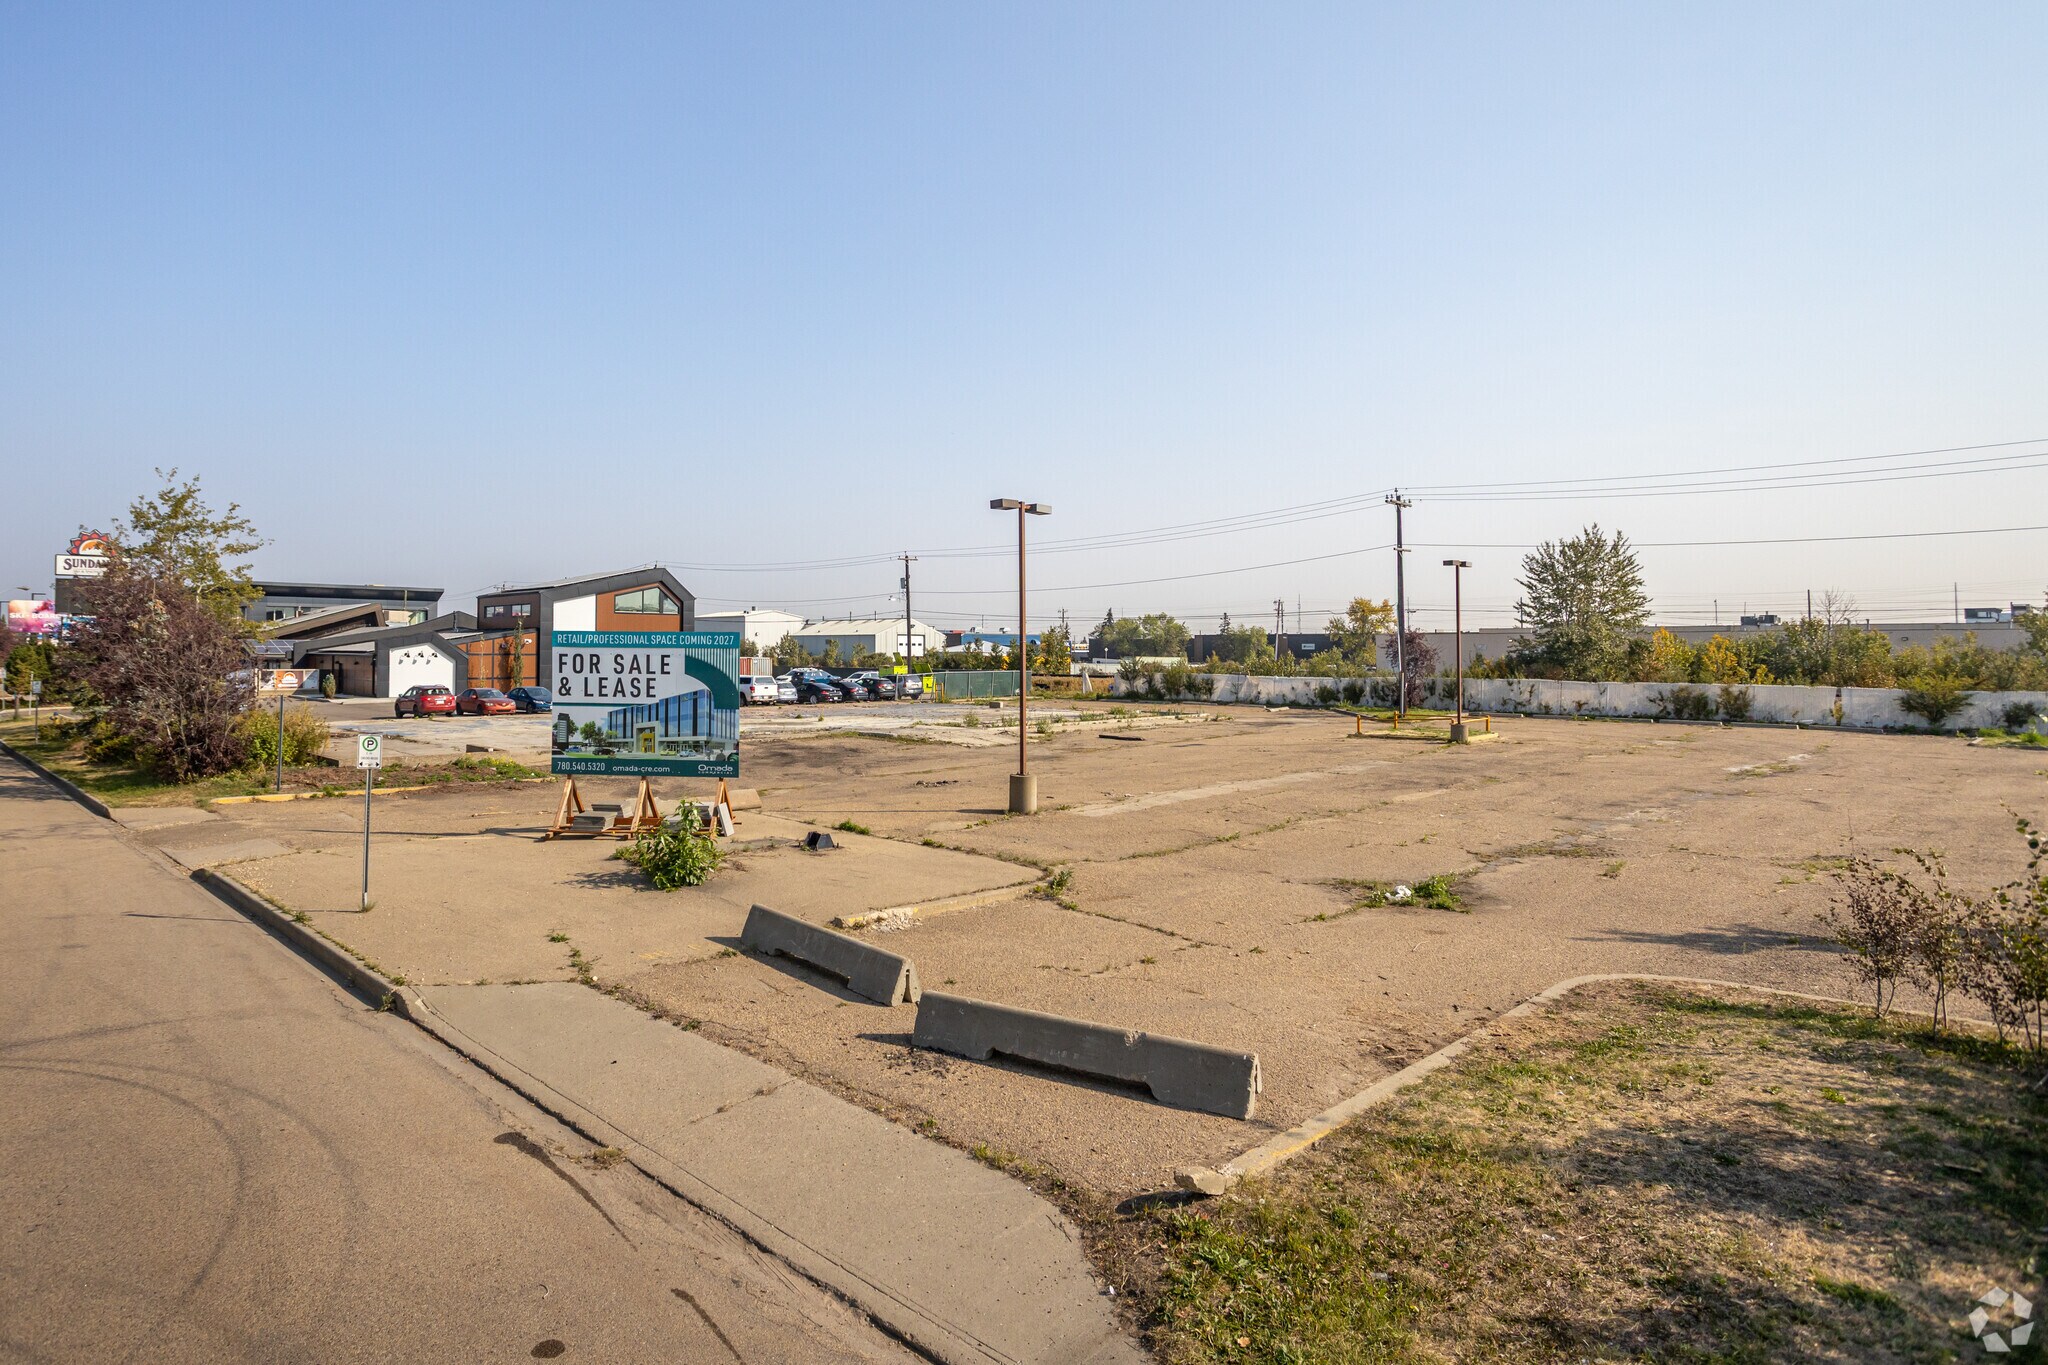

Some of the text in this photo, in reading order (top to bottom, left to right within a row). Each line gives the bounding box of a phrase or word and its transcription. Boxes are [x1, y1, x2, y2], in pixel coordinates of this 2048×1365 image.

[557, 634, 734, 645] RETAIL/PROFESSIONAL SPACE COMING 2027
[558, 653, 671, 675] FOR SALE
[558, 676, 657, 698] & LEASE
[367, 740, 375, 748] P
[557, 761, 671, 773] 780.540.5320 omada-cre.com
[698, 764, 733, 772] Omada
